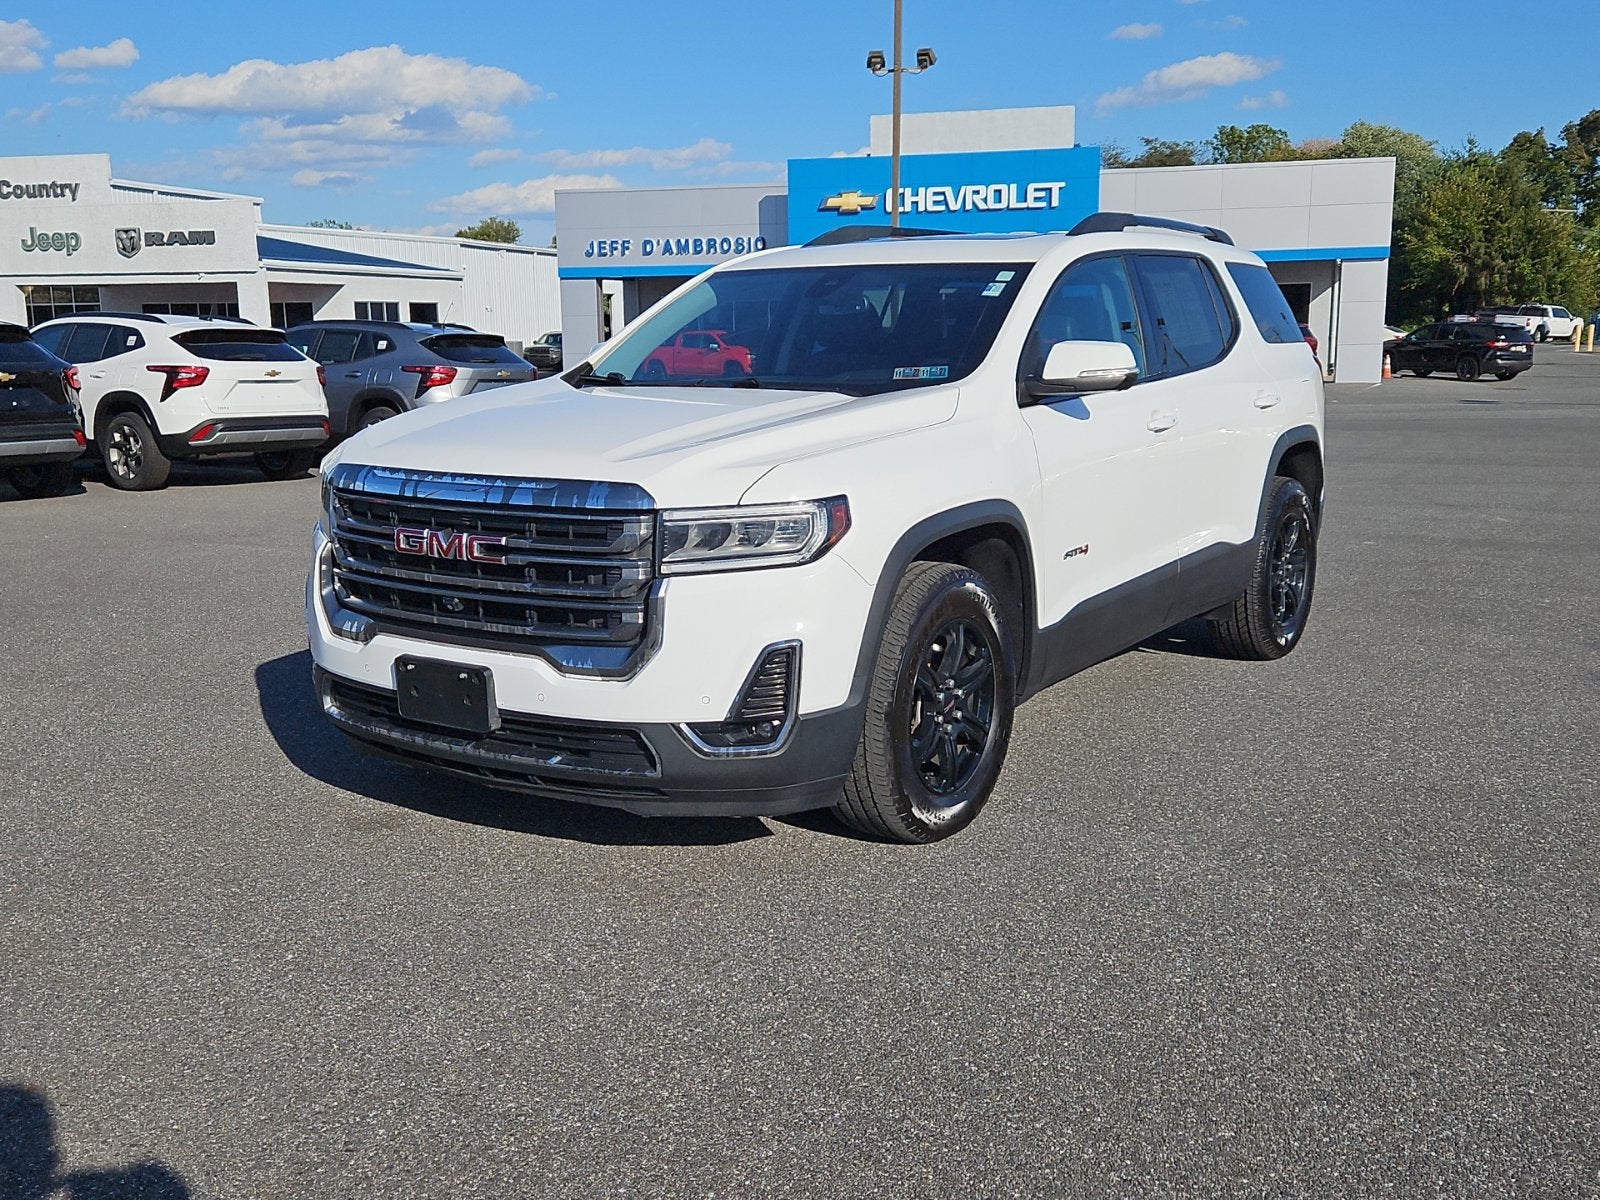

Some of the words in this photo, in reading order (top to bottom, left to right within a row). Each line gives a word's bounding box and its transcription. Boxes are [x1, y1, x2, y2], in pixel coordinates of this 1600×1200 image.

[0, 179, 80, 202] Country
[885, 181, 1066, 213] CHEVROLET
[20, 226, 82, 256] Jeep
[144, 230, 216, 247] RAM
[584, 239, 632, 258] JEFF
[641, 236, 767, 256] D'AMBROSIO
[394, 526, 508, 565] GMC
[1062, 543, 1089, 560] AT4
